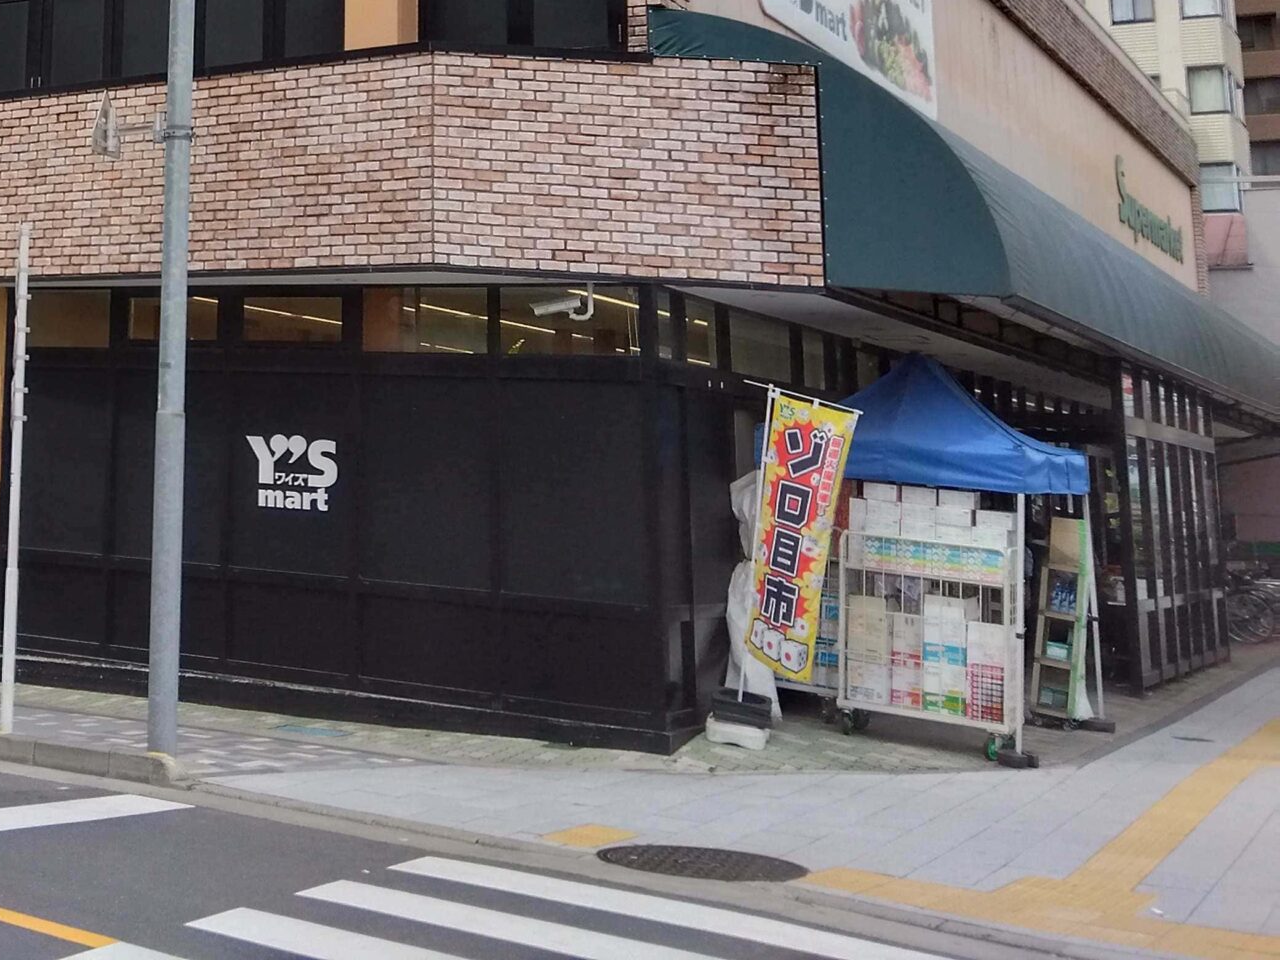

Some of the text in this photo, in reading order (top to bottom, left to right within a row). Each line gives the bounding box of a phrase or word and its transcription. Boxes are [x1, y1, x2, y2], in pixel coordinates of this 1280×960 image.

[814, 0, 847, 41] mart
[274, 471, 308, 486] ワイズ
[258, 487, 329, 512] mart
[760, 427, 828, 628] ゾロ目市
